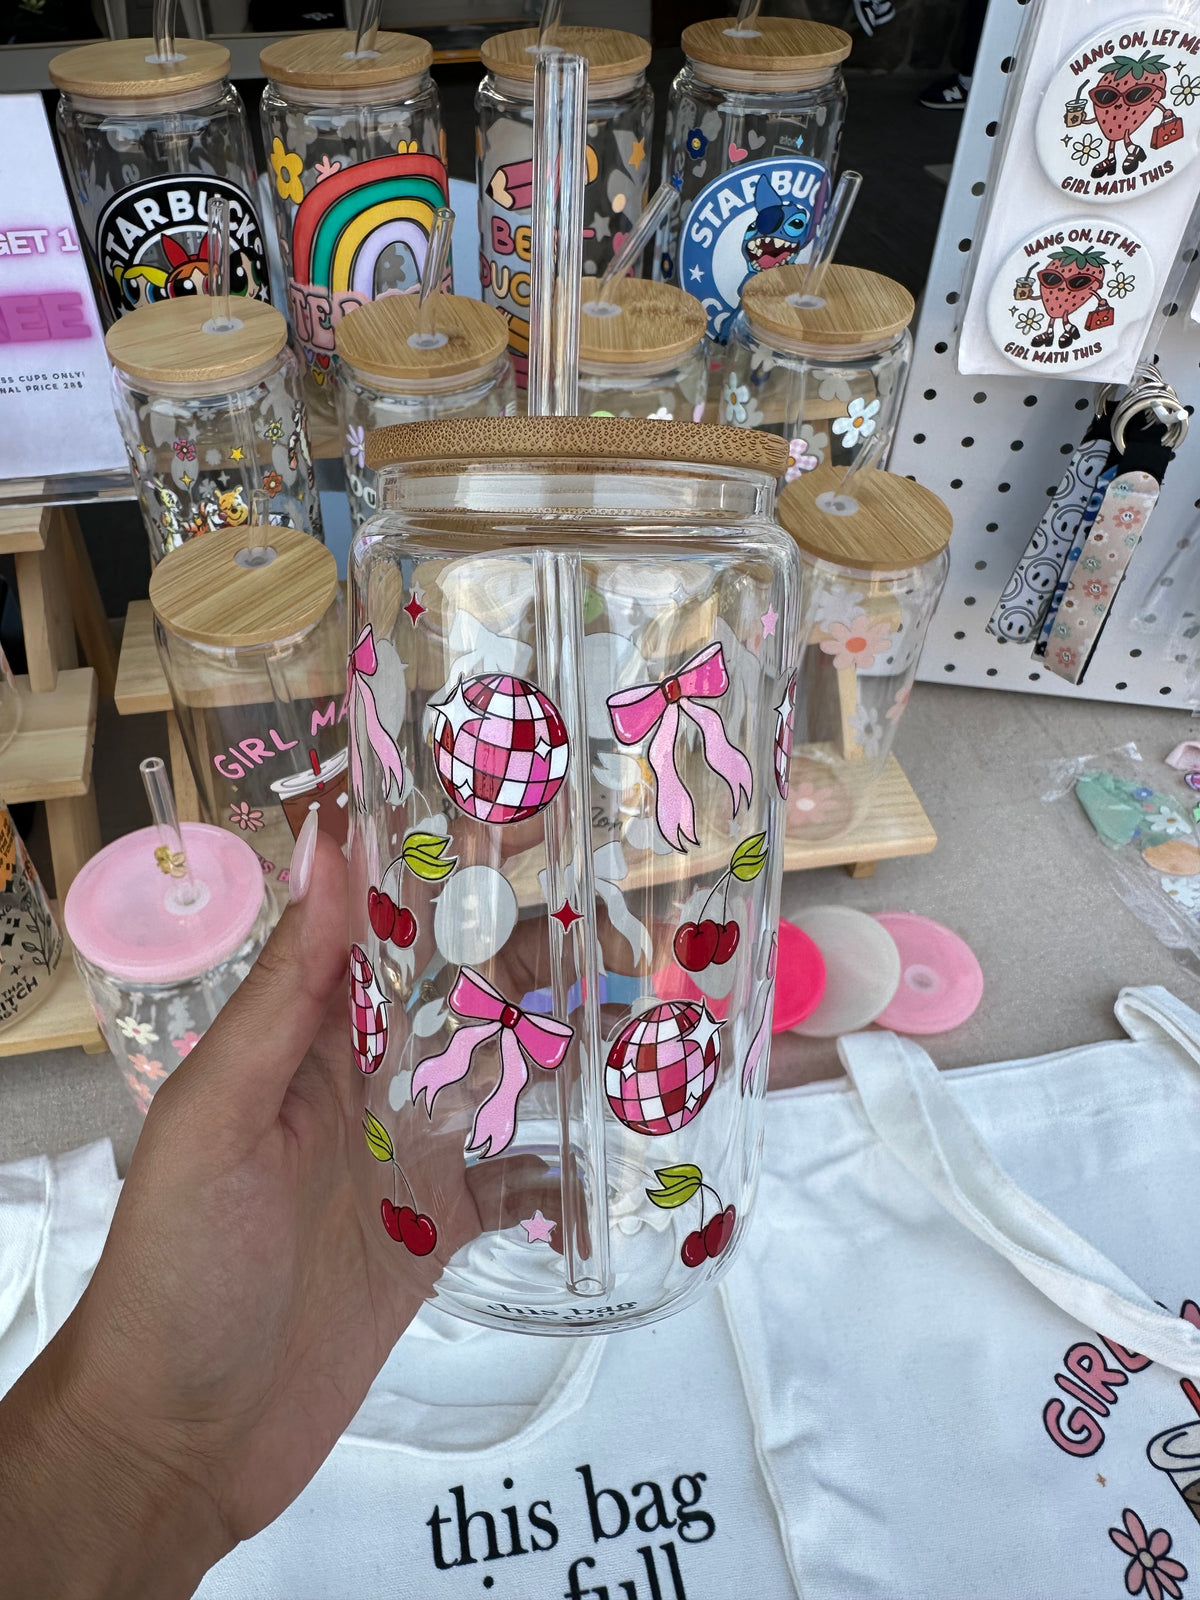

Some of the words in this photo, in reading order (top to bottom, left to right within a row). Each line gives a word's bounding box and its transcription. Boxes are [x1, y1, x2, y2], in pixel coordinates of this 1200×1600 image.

[1069, 40, 1115, 76] HANG
[1118, 30, 1149, 50] ON,
[1152, 29, 1180, 47] LET
[1177, 33, 1200, 55] ME
[1061, 176, 1090, 195] GIRL
[1094, 176, 1137, 196] MATH
[1139, 160, 1175, 186] THIS
[57, 228, 79, 253] 1
[1023, 231, 1065, 258] HANG
[1067, 228, 1094, 243] ON,
[1095, 229, 1122, 247] LET
[1117, 236, 1142, 258] ME
[1003, 341, 1030, 361] GIRL
[1031, 350, 1070, 365] MATH
[1072, 341, 1103, 361] THIS
[18, 373, 48, 383] CUPS
[52, 370, 86, 381] ONLY!
[25, 382, 59, 393] PRICE
[213, 728, 299, 780] GIRL
[0, 975, 39, 1012] ITCH
[426, 1477, 559, 1570] this
[575, 1464, 716, 1543] bag
